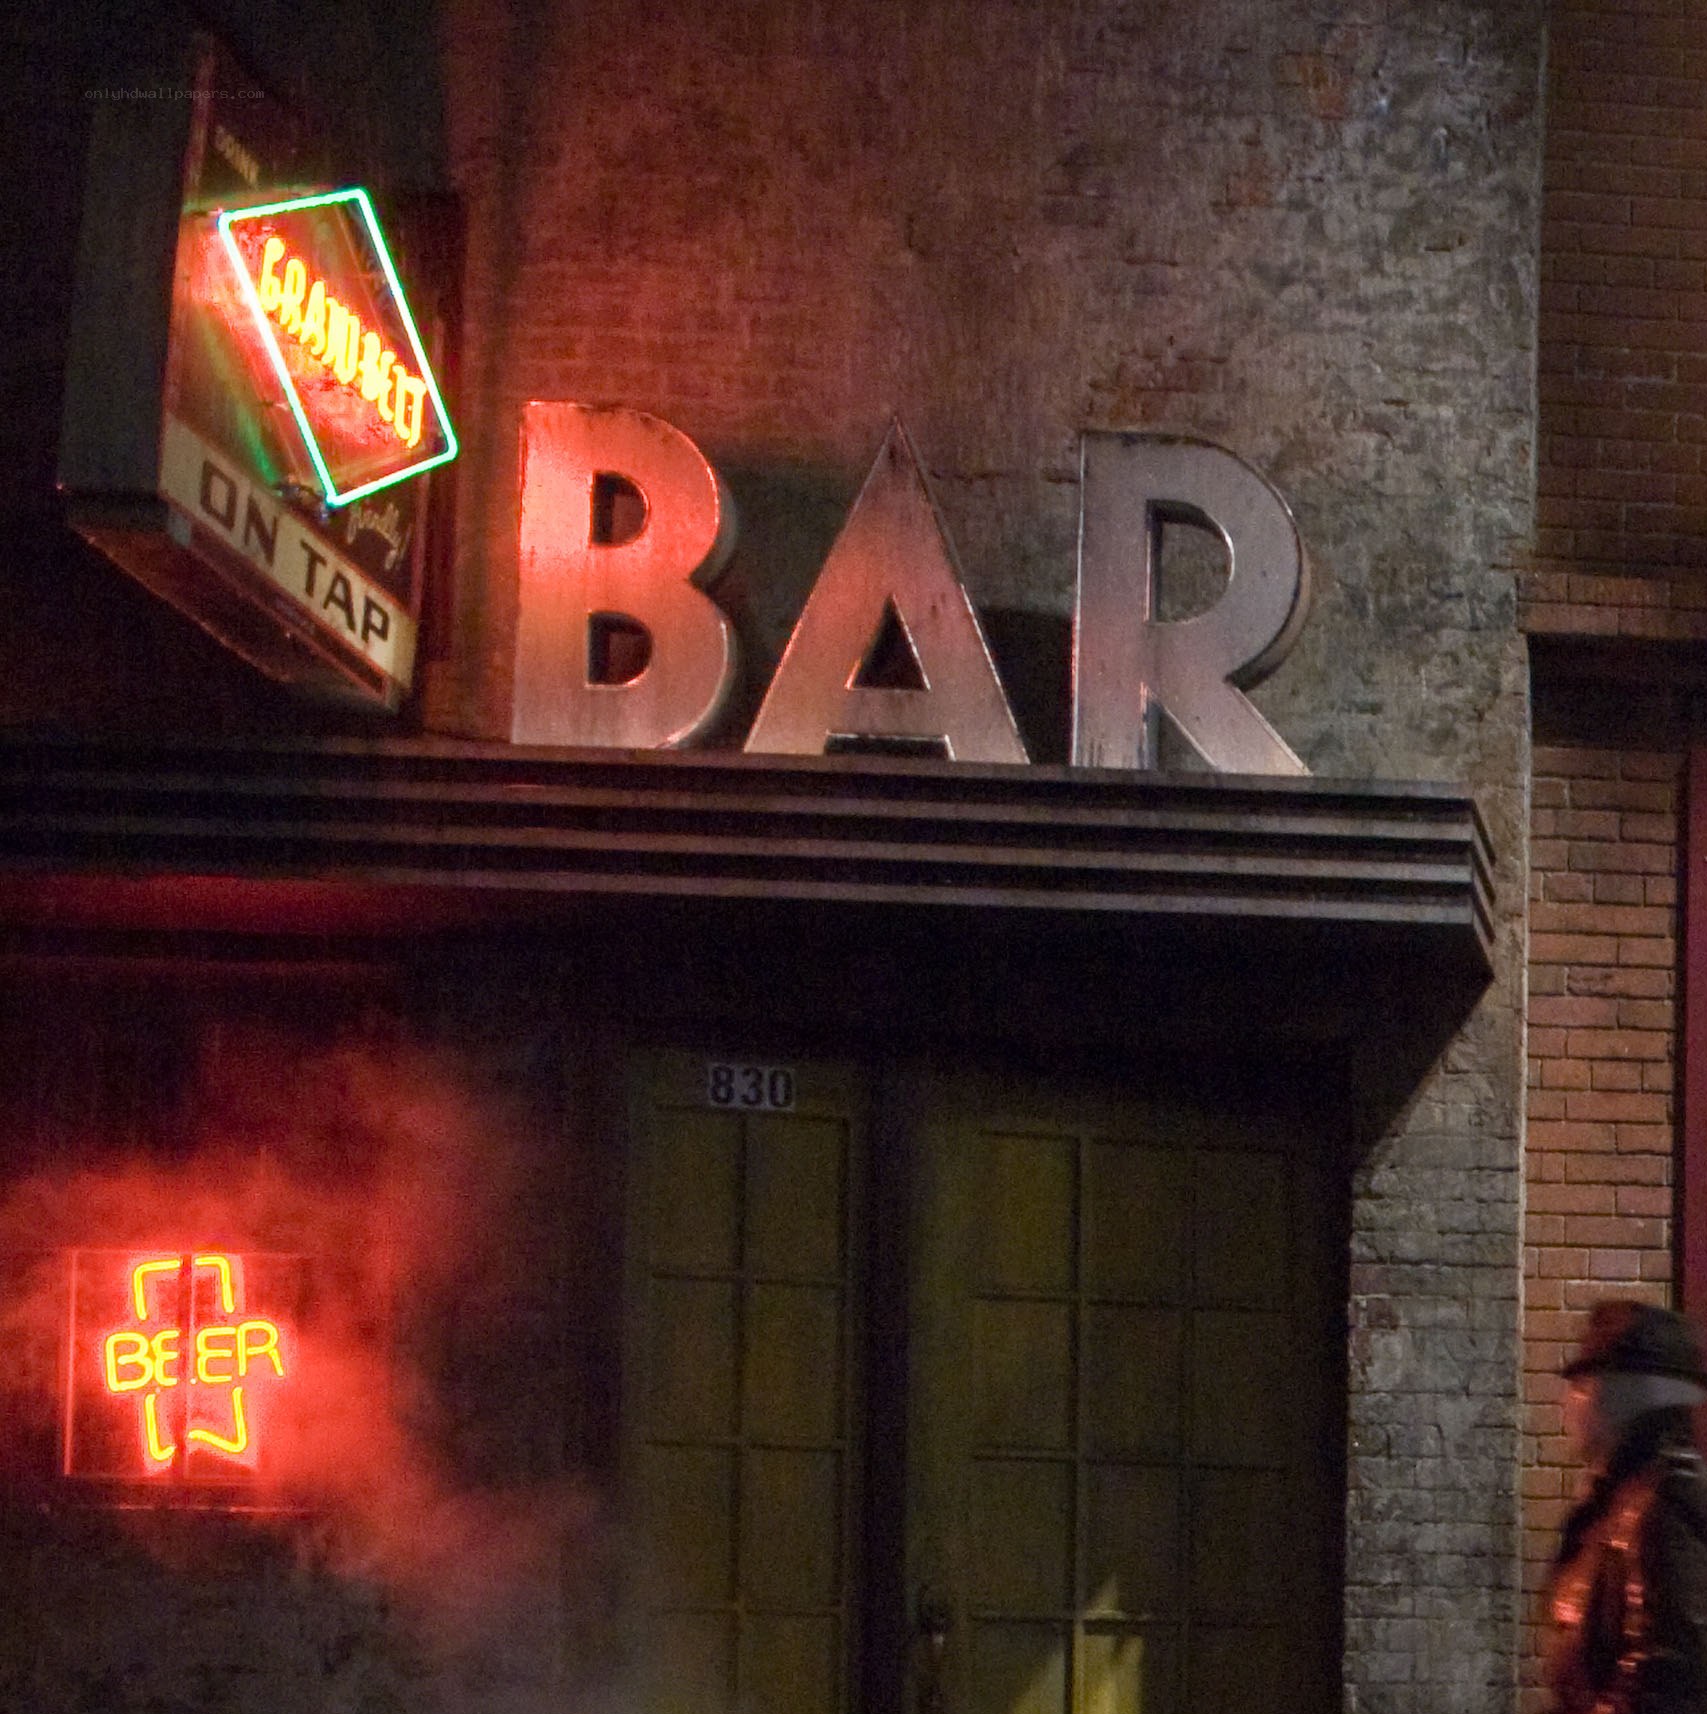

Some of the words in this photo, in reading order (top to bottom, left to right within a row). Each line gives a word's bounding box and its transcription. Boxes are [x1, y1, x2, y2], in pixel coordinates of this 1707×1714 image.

[202, 458, 278, 569] ON
[300, 540, 390, 645] TAP
[511, 400, 1315, 776] BAR
[709, 1064, 796, 1112] 830
[105, 1320, 284, 1392] BEER
